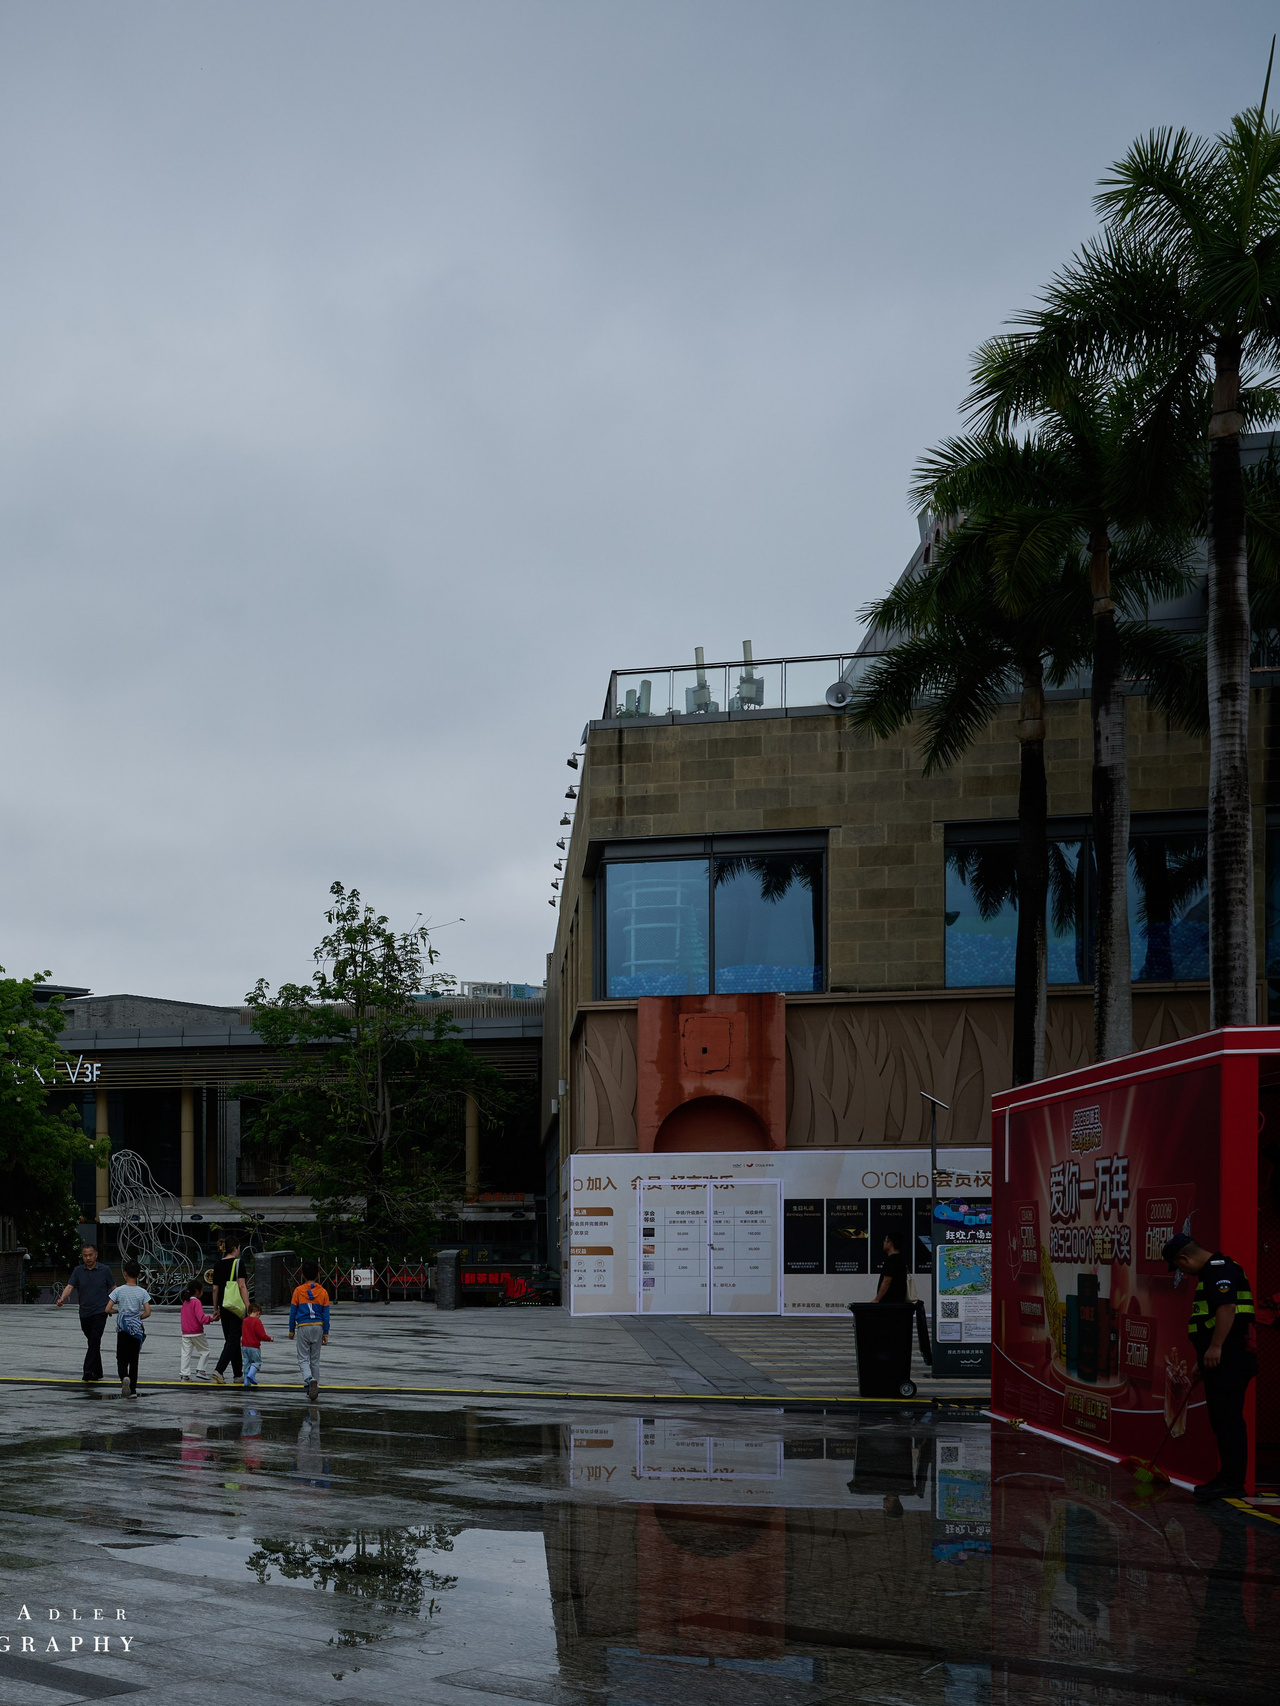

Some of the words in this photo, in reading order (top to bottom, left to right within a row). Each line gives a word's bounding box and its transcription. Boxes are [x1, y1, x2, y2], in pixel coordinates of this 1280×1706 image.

[586, 1176, 618, 1192] 加入
[861, 1171, 929, 1189] O'Club
[1050, 1154, 1130, 1221] 爱你一万年
[1050, 1226, 1131, 1263] 抢5200个黄金大奖
